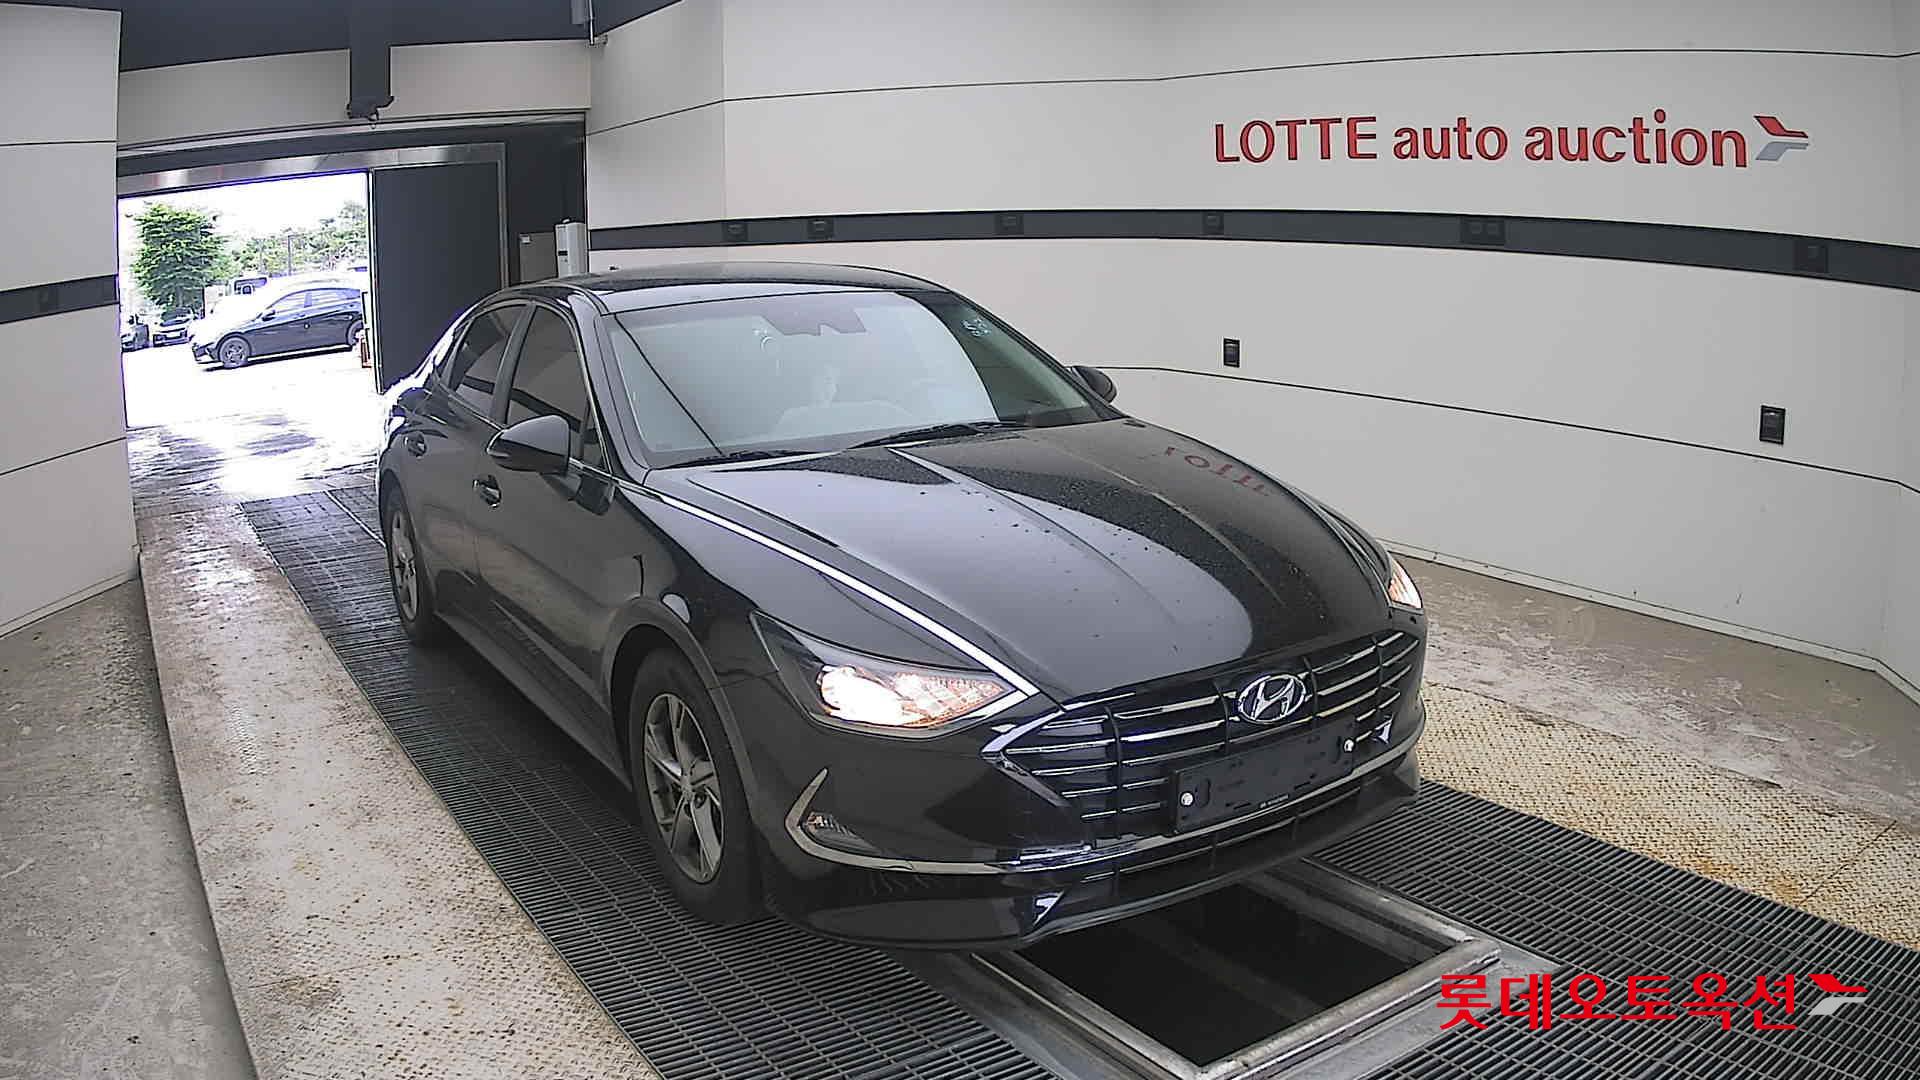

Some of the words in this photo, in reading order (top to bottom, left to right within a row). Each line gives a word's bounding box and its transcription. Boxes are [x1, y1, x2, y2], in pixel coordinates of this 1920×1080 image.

[1214, 115, 1377, 162] LOTTE
[1392, 117, 1509, 161] auto
[1523, 109, 1748, 168] auction
